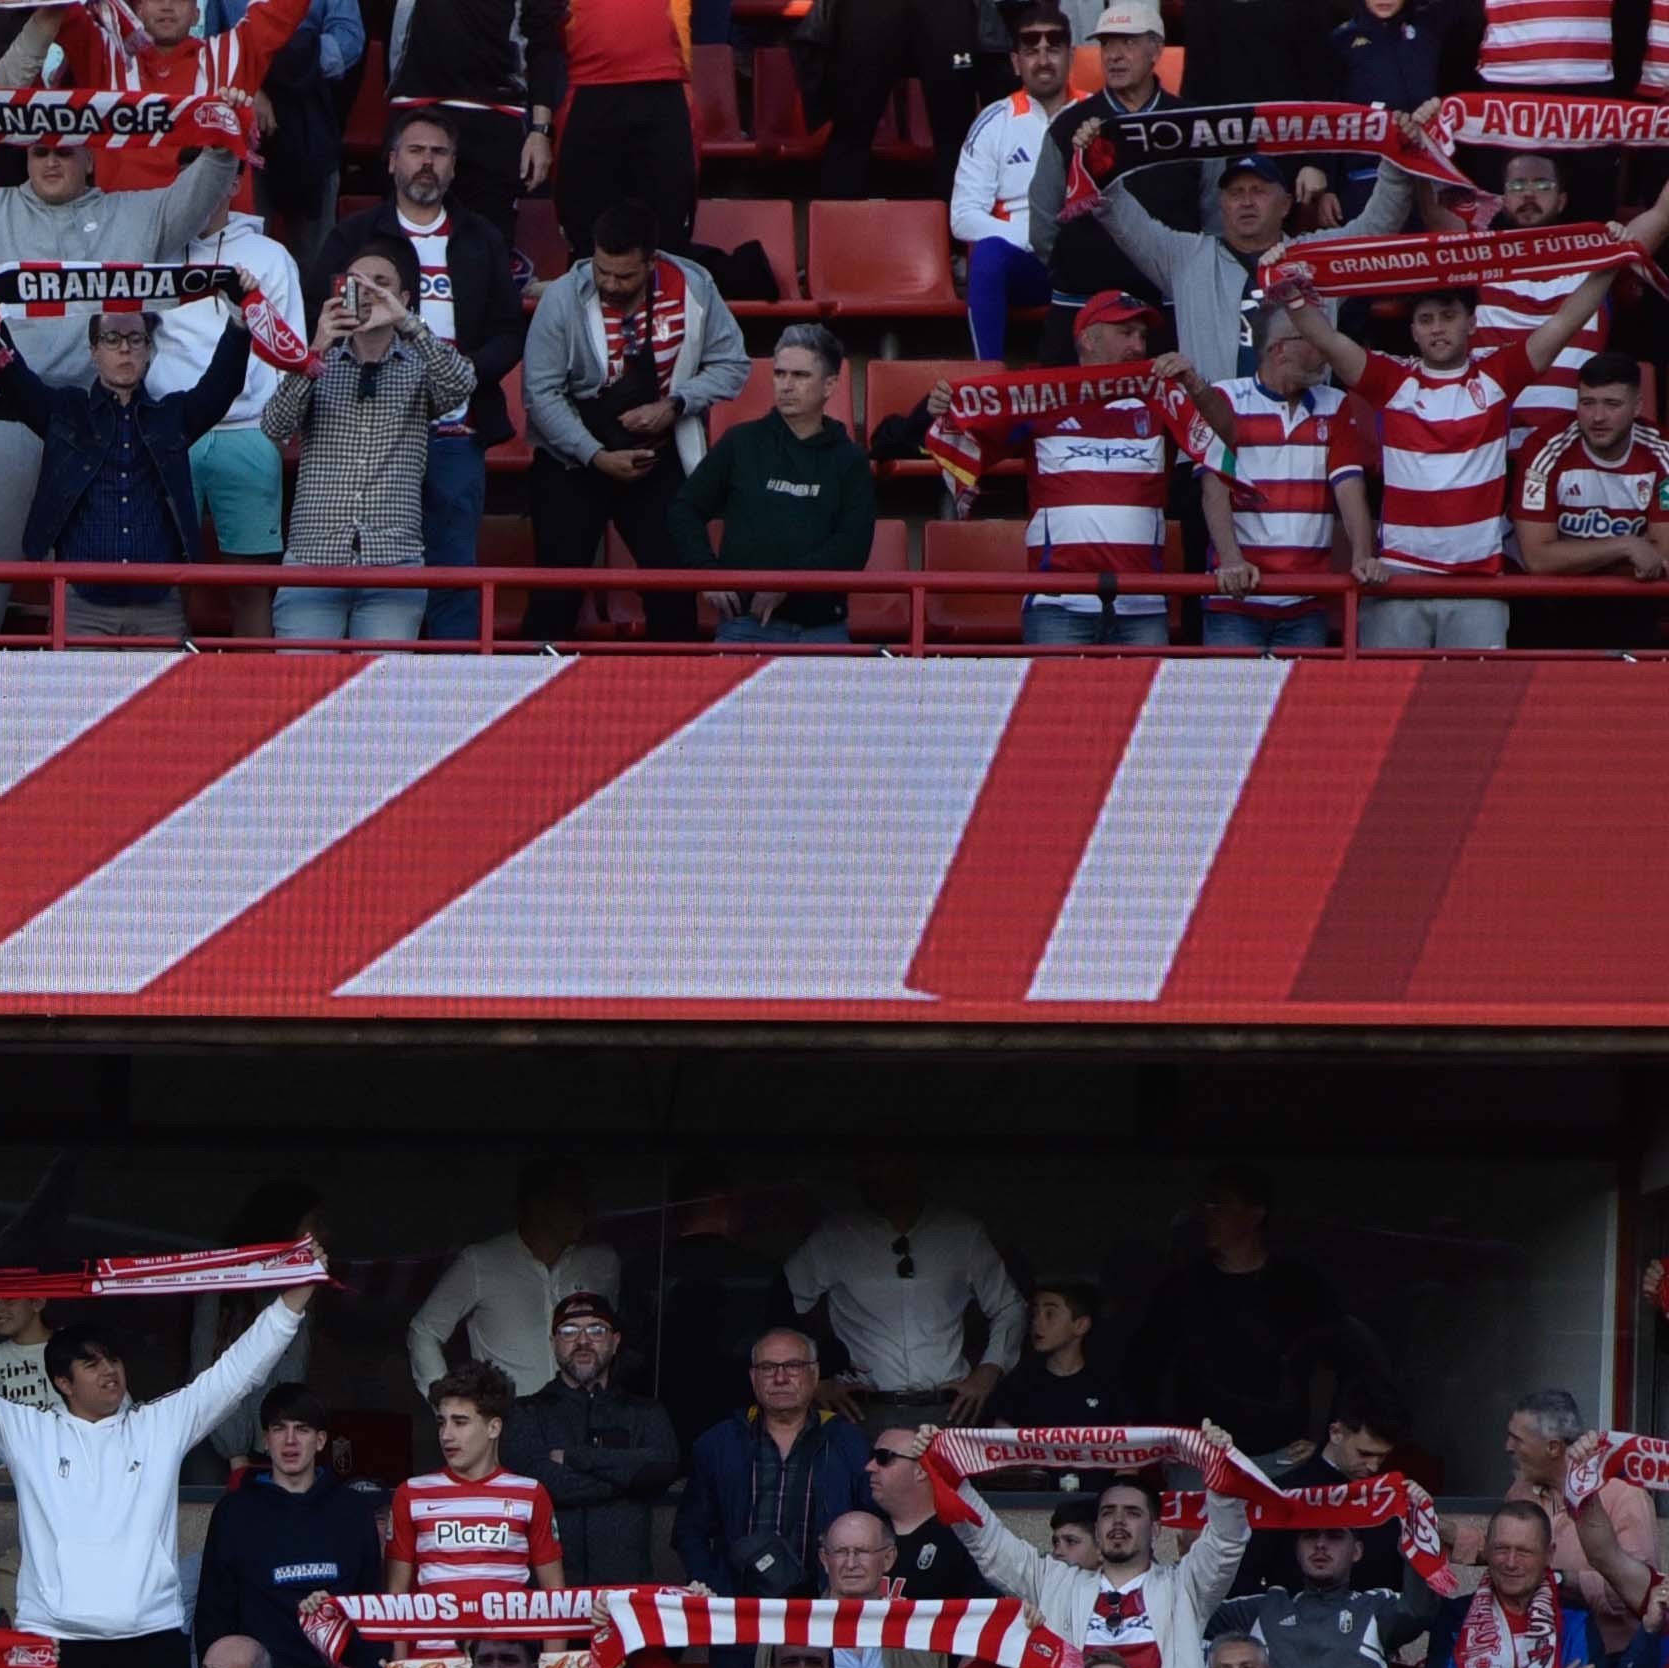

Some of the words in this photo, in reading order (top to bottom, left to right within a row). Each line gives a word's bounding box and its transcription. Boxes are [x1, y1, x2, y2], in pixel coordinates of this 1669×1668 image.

[111, 107, 174, 136] C.F.
[1329, 248, 1430, 276] GRANADA
[1436, 243, 1493, 267] CLUB
[1499, 239, 1529, 260] DE
[1534, 230, 1612, 256] FÚTBOL
[17, 269, 177, 302] GRANADA
[181, 267, 232, 296] CF
[1558, 508, 1646, 537] wiber
[1017, 1428, 1127, 1445] GRANADA
[434, 1522, 509, 1546] Platzi
[338, 1592, 459, 1620] VAMOS
[464, 1600, 479, 1613] MI
[481, 1589, 593, 1619] GRANA
